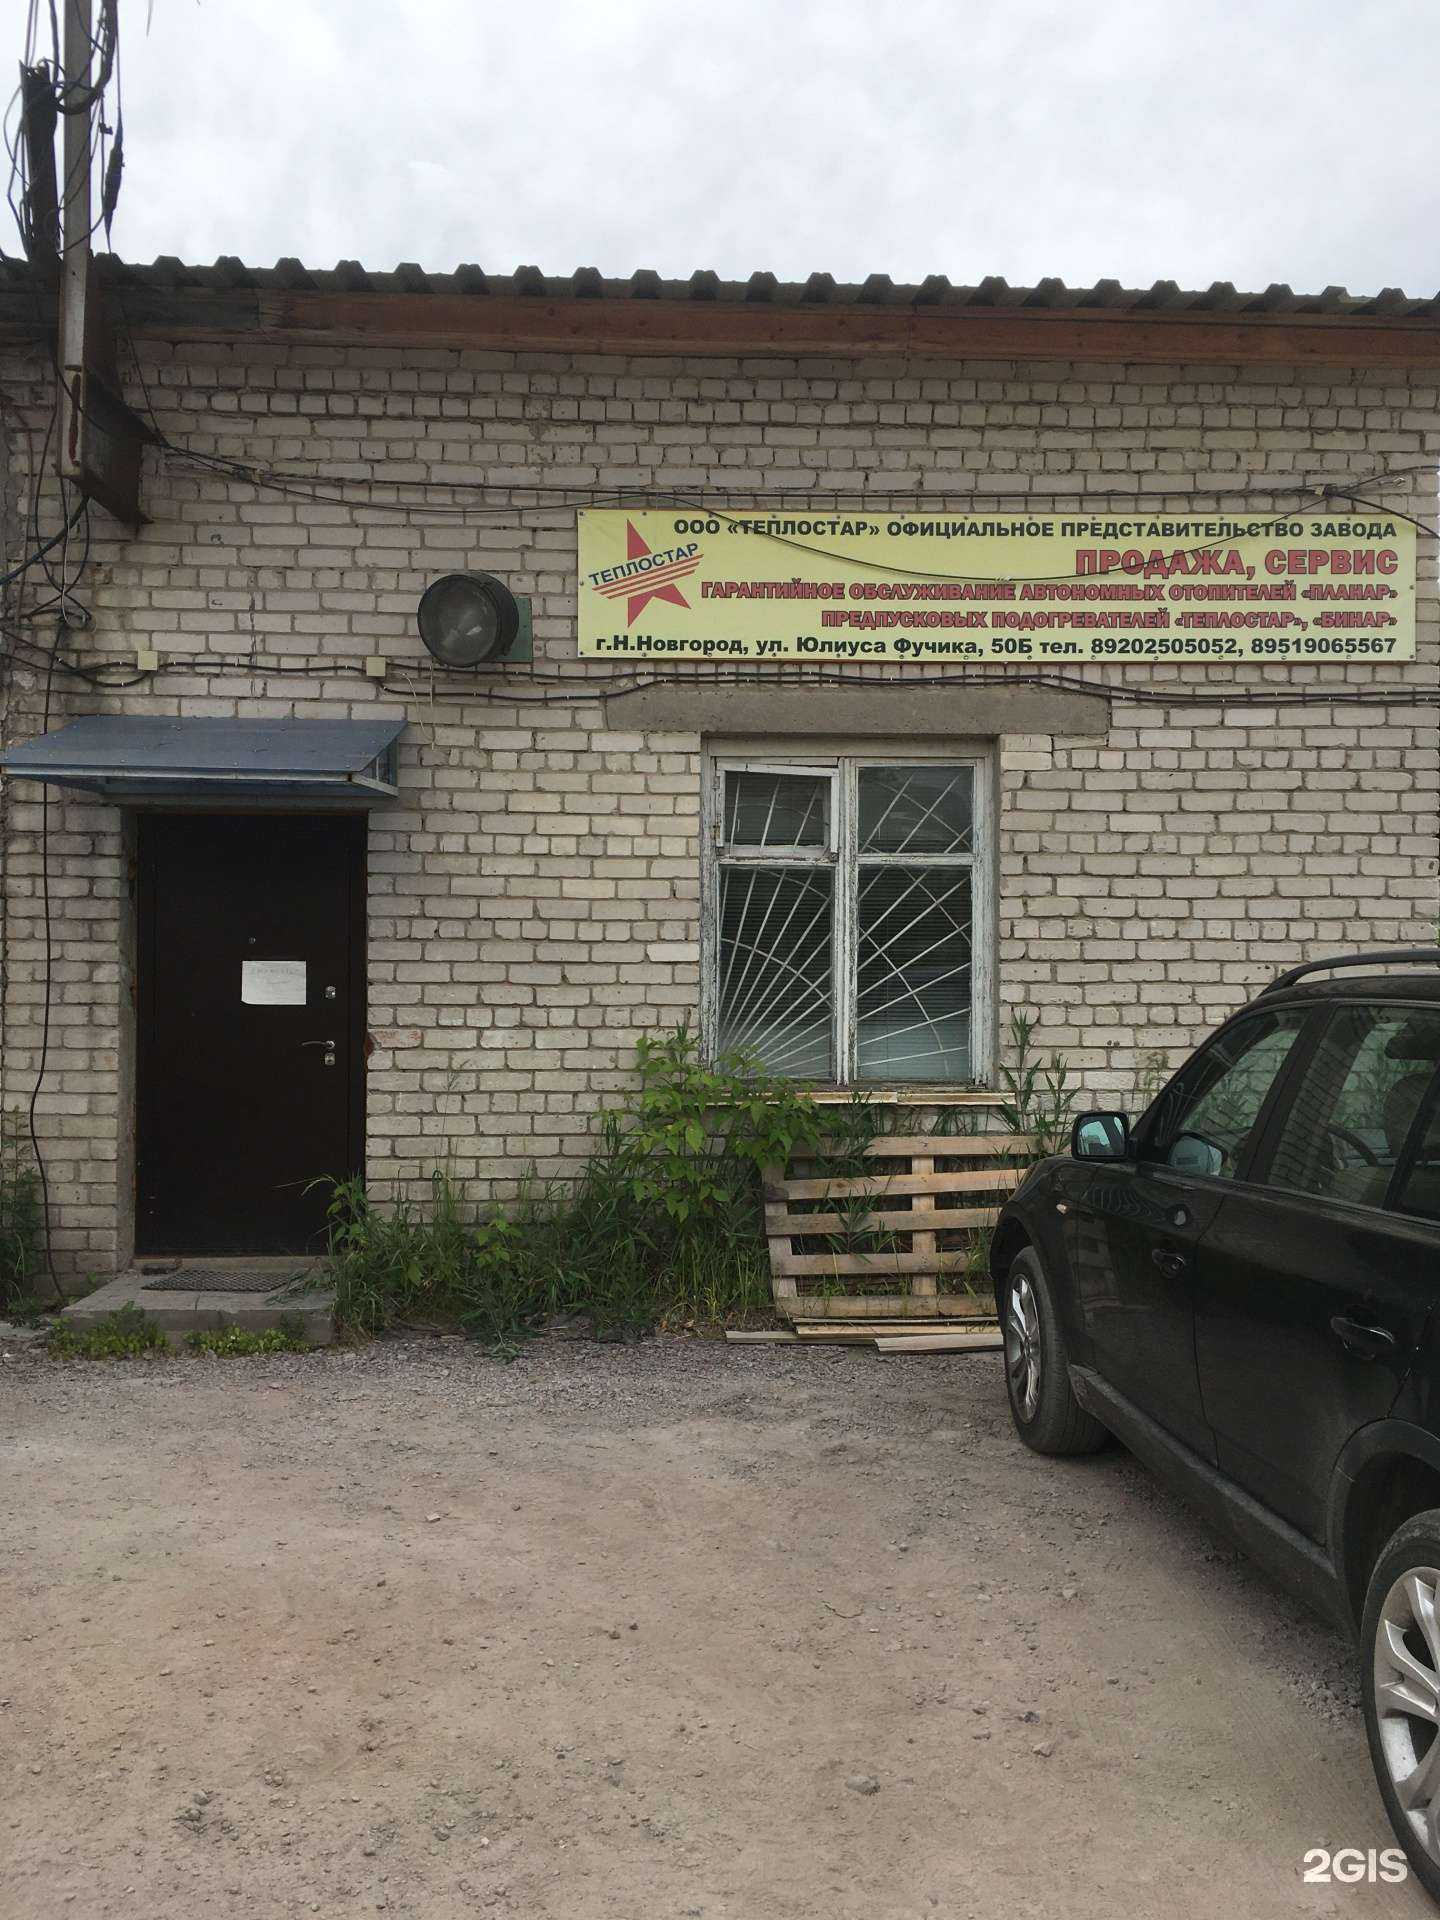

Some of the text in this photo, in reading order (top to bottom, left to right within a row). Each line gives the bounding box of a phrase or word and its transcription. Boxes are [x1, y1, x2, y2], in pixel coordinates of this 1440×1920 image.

[674, 519, 1397, 540] ООО «ТЕПЛОСТАР» ОФИЦИАЛЬНОЕ ПРЕДСТАВИТЕЛЬСТВО ЗАВОДА
[588, 542, 699, 586] ТЕПЛОСТАР
[1075, 549, 1399, 579] ПРОДАЖА, СЕРВИС
[701, 578, 1398, 601] ГАРАНТИЙНОЕ ОБСЛУЖИВАНИЕ АВТОНОМНЫХ ОТОПИТЕЛЕЙ «ПЛАНАР»
[821, 611, 988, 630] ПРЕДПУСКОВЫХ
[992, 608, 1170, 631] ПОДОГРЕВАТЕЛЕЙ
[1312, 613, 1398, 629] «БИНАР»
[756, 639, 789, 656] ул.
[797, 637, 886, 657] Юлиуса
[893, 638, 983, 659] Фучика,
[991, 638, 1032, 655] 50Б
[1040, 641, 1083, 655] тел.
[1091, 638, 1244, 658] 89202505052,
[1251, 638, 1397, 655] 89519065567
